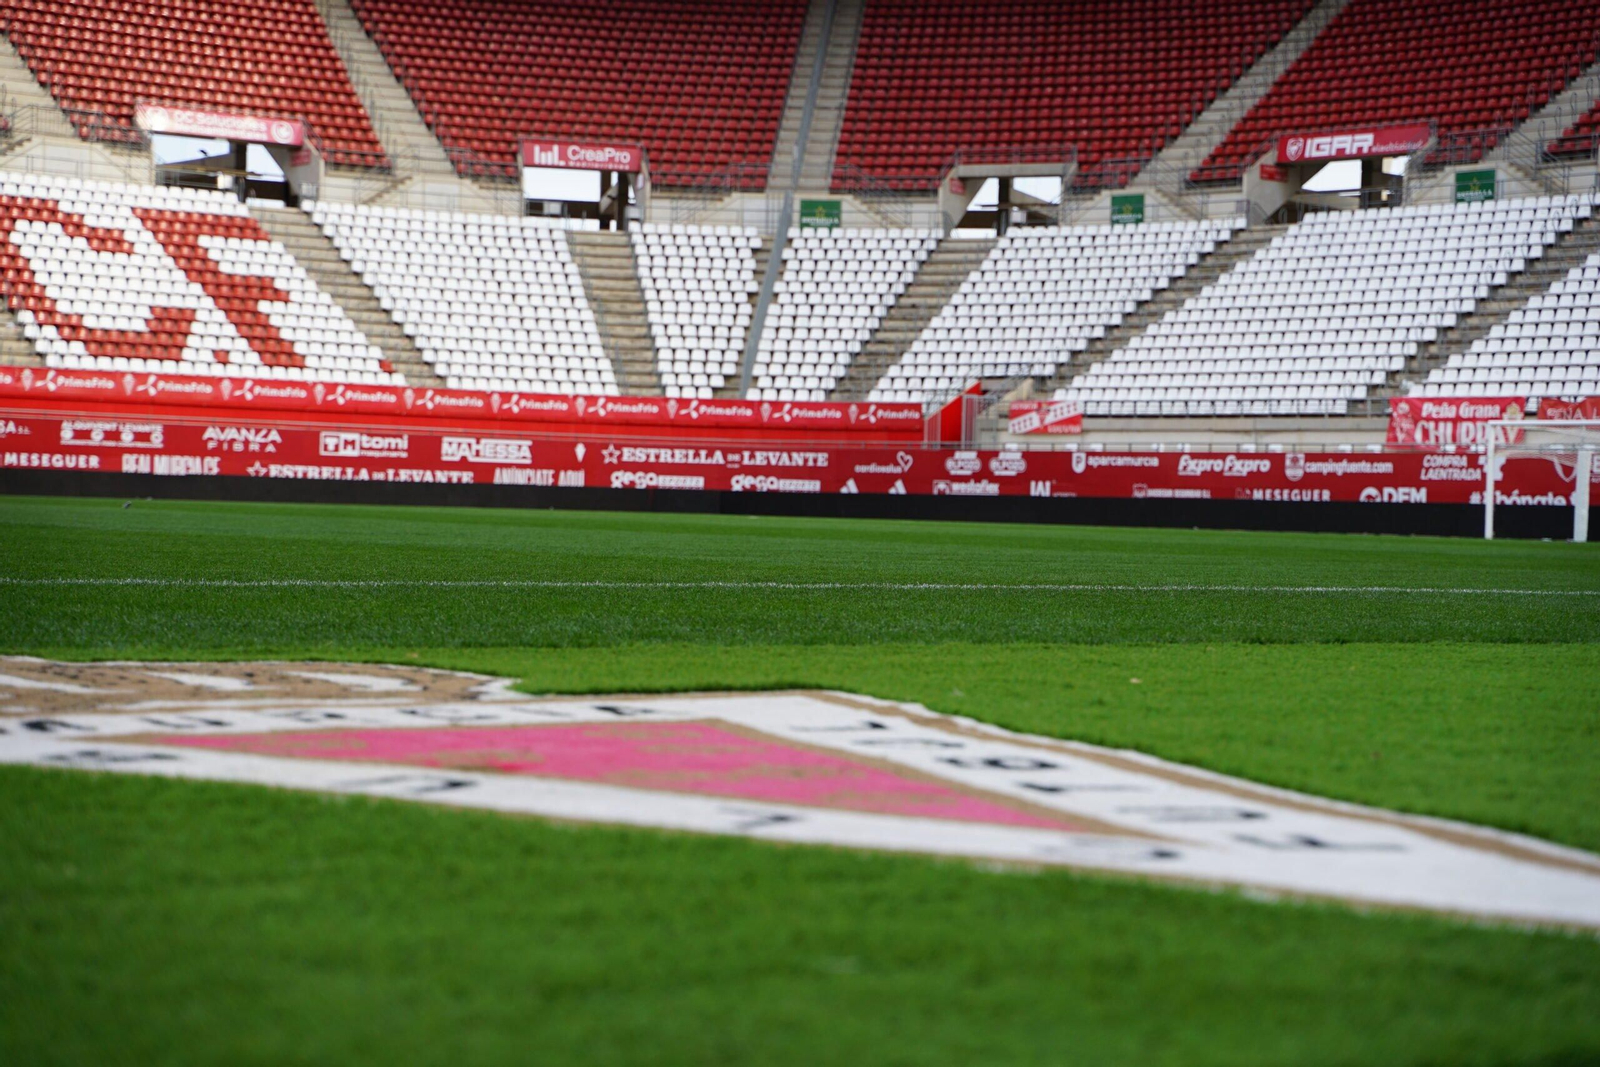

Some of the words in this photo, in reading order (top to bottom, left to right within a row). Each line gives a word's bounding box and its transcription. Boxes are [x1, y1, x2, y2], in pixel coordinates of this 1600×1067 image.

[1304, 133, 1374, 158] IGAR
[567, 145, 631, 164] CreaPro
[57, 375, 115, 389] PrimaFrio
[157, 380, 213, 394] PrimaFrio
[253, 386, 308, 398] PrimaFrio
[345, 391, 397, 403] PrimaFrio
[434, 395, 484, 407] PrimaFrio
[519, 399, 569, 411] PrimaFrio
[606, 402, 659, 414] PrimaFrio
[700, 405, 753, 417] PrimaFrio
[792, 408, 842, 419] PrimaFrio
[877, 409, 920, 420] PrimaFrio
[1421, 402, 1457, 418] Peña
[1459, 401, 1501, 418] Grana
[202, 426, 282, 443] AVANZA
[207, 440, 277, 453] FIBRA
[361, 434, 409, 450] tomi
[441, 438, 532, 463] MAHESSA
[621, 447, 726, 465] ESTRELLA
[742, 450, 829, 467] LEVANTE
[4, 452, 100, 469] MESEGUER
[1087, 455, 1160, 468] aparcamurcia
[1423, 454, 1468, 468] COMPRA
[268, 464, 370, 481] ESTRELLA
[387, 469, 474, 484] LEVANTE
[1252, 488, 1331, 501] MESEGUER
[1469, 488, 1567, 506] #bónate
